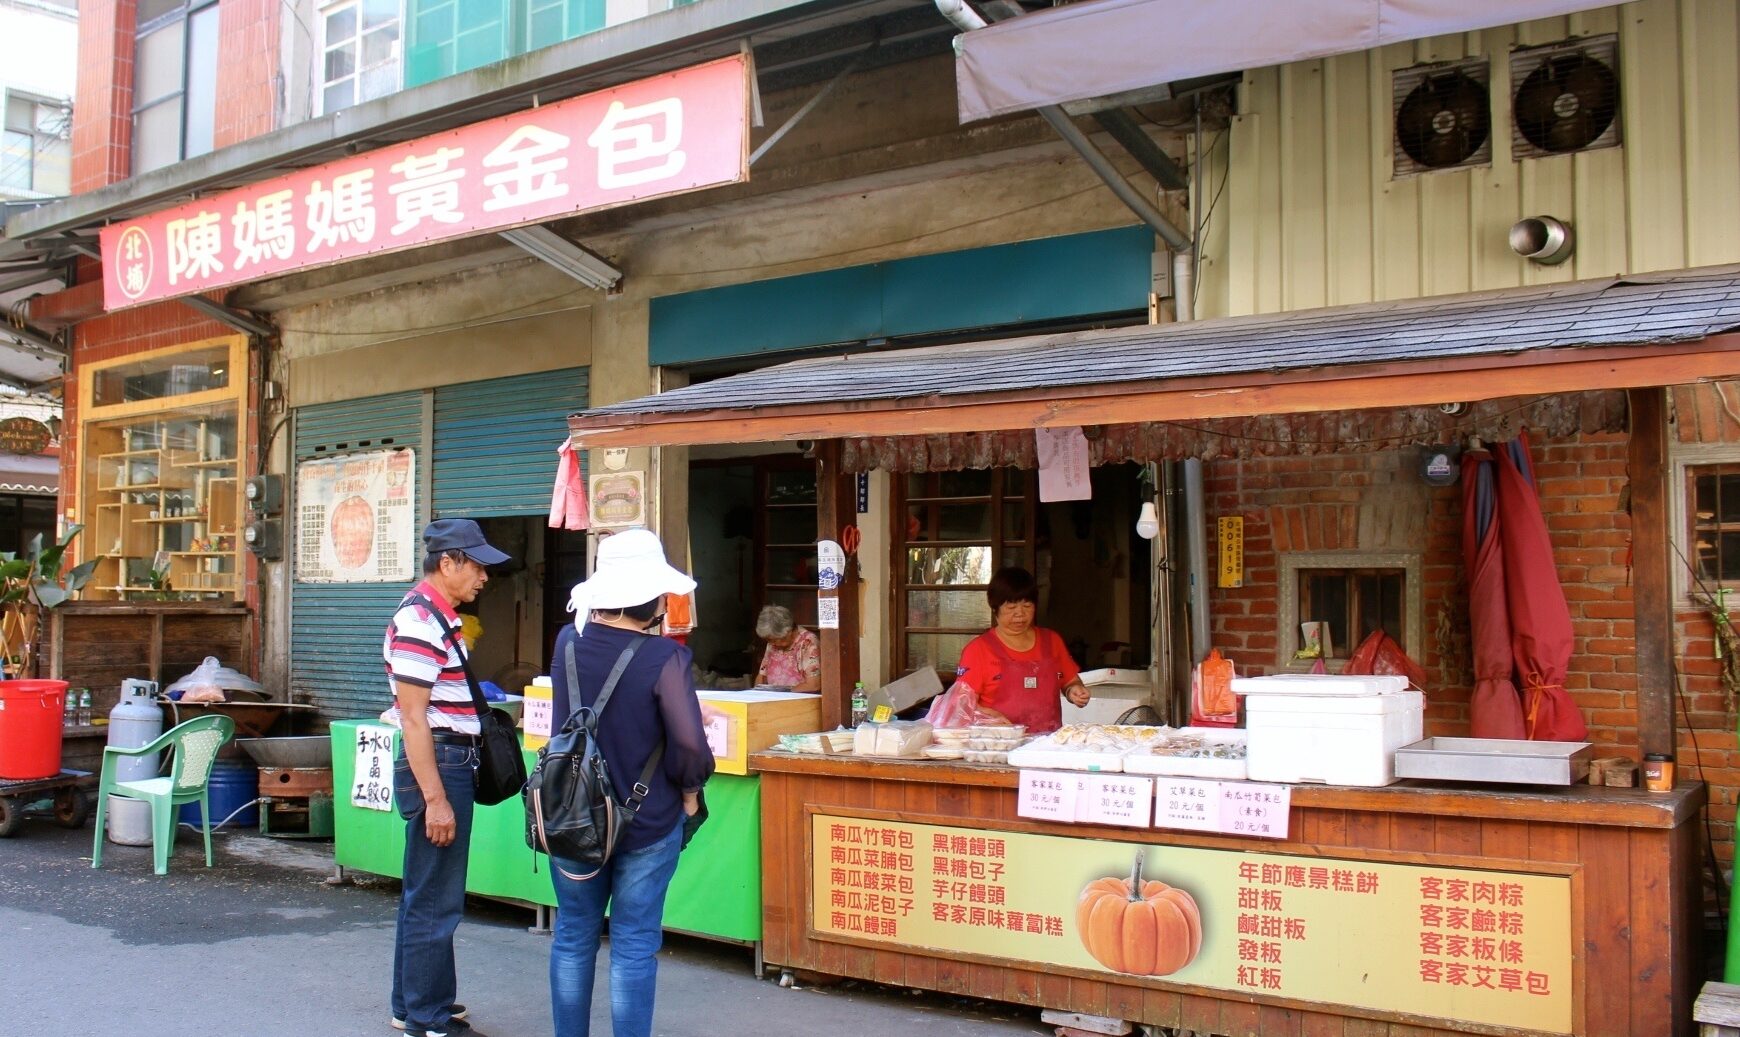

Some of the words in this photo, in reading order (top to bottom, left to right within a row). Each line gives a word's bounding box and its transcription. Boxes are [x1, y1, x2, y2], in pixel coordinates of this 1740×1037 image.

[166, 97, 687, 285] 陳媽媽黃金包
[126, 233, 143, 291] 北埔
[1226, 521, 1234, 574] 00619
[1030, 793, 1038, 802] 30
[1031, 780, 1062, 791] 客家菜包
[1102, 784, 1136, 795] 客家菜包
[1170, 787, 1206, 798] 艾草菜包
[1225, 790, 1281, 803] 南瓜竹筍菜包
[1101, 798, 1110, 807] 30
[1169, 800, 1178, 810] 20
[830, 823, 914, 850] 南瓜竹筍包
[1234, 821, 1245, 830] 20
[830, 845, 914, 872] 南瓜菜脯包
[932, 833, 1005, 859] 黑糖饅頭
[830, 867, 914, 895] 南瓜酸菜包
[932, 856, 1005, 882] 黑糖包子
[1238, 861, 1379, 895] 年節應景糕餅
[830, 889, 914, 917] 南瓜泥包子
[932, 879, 1005, 906] 芋仔饅頭
[1238, 887, 1282, 912] 甜粄
[1420, 876, 1524, 907] 客家肉粽
[831, 911, 898, 937] 南瓜饅頭
[932, 902, 1064, 937] 客家原味蘿蔔糕
[1237, 912, 1306, 941] 鹹甜粄
[1420, 904, 1524, 936] 客家鹼粽
[1237, 938, 1282, 964] 發粄
[1420, 932, 1524, 965] 客家粄條
[1236, 964, 1282, 990] 紅粄
[1420, 959, 1551, 996] 客家艾草包
